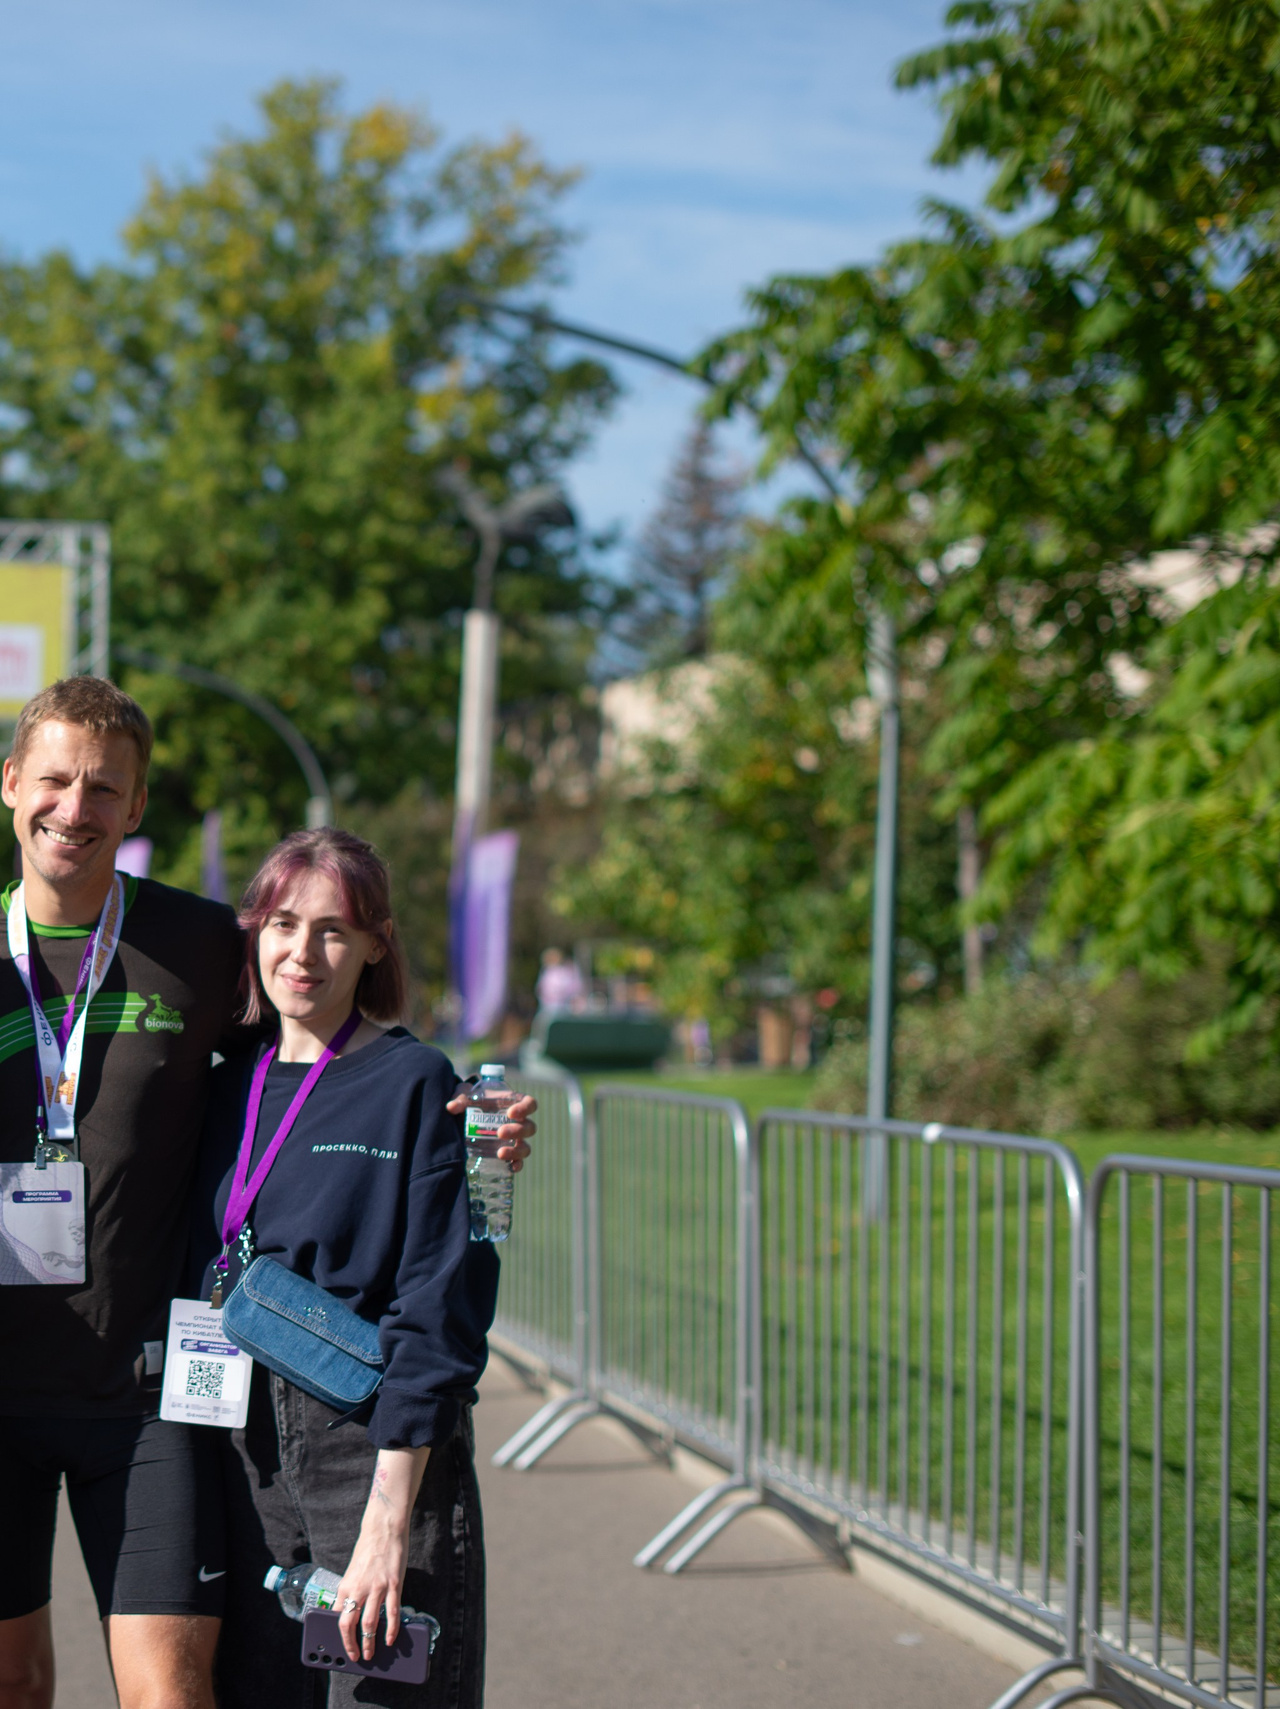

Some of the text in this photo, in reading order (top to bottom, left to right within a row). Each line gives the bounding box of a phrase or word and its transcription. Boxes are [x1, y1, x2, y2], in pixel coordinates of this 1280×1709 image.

[145, 1017, 184, 1030] bionova
[312, 1144, 398, 1159] ПРОСЕККО, ПЛИЗ
[175, 1321, 218, 1330] ЧЕМПИОНАТ
[199, 1341, 238, 1350] ОРГАНИЗАТОР
